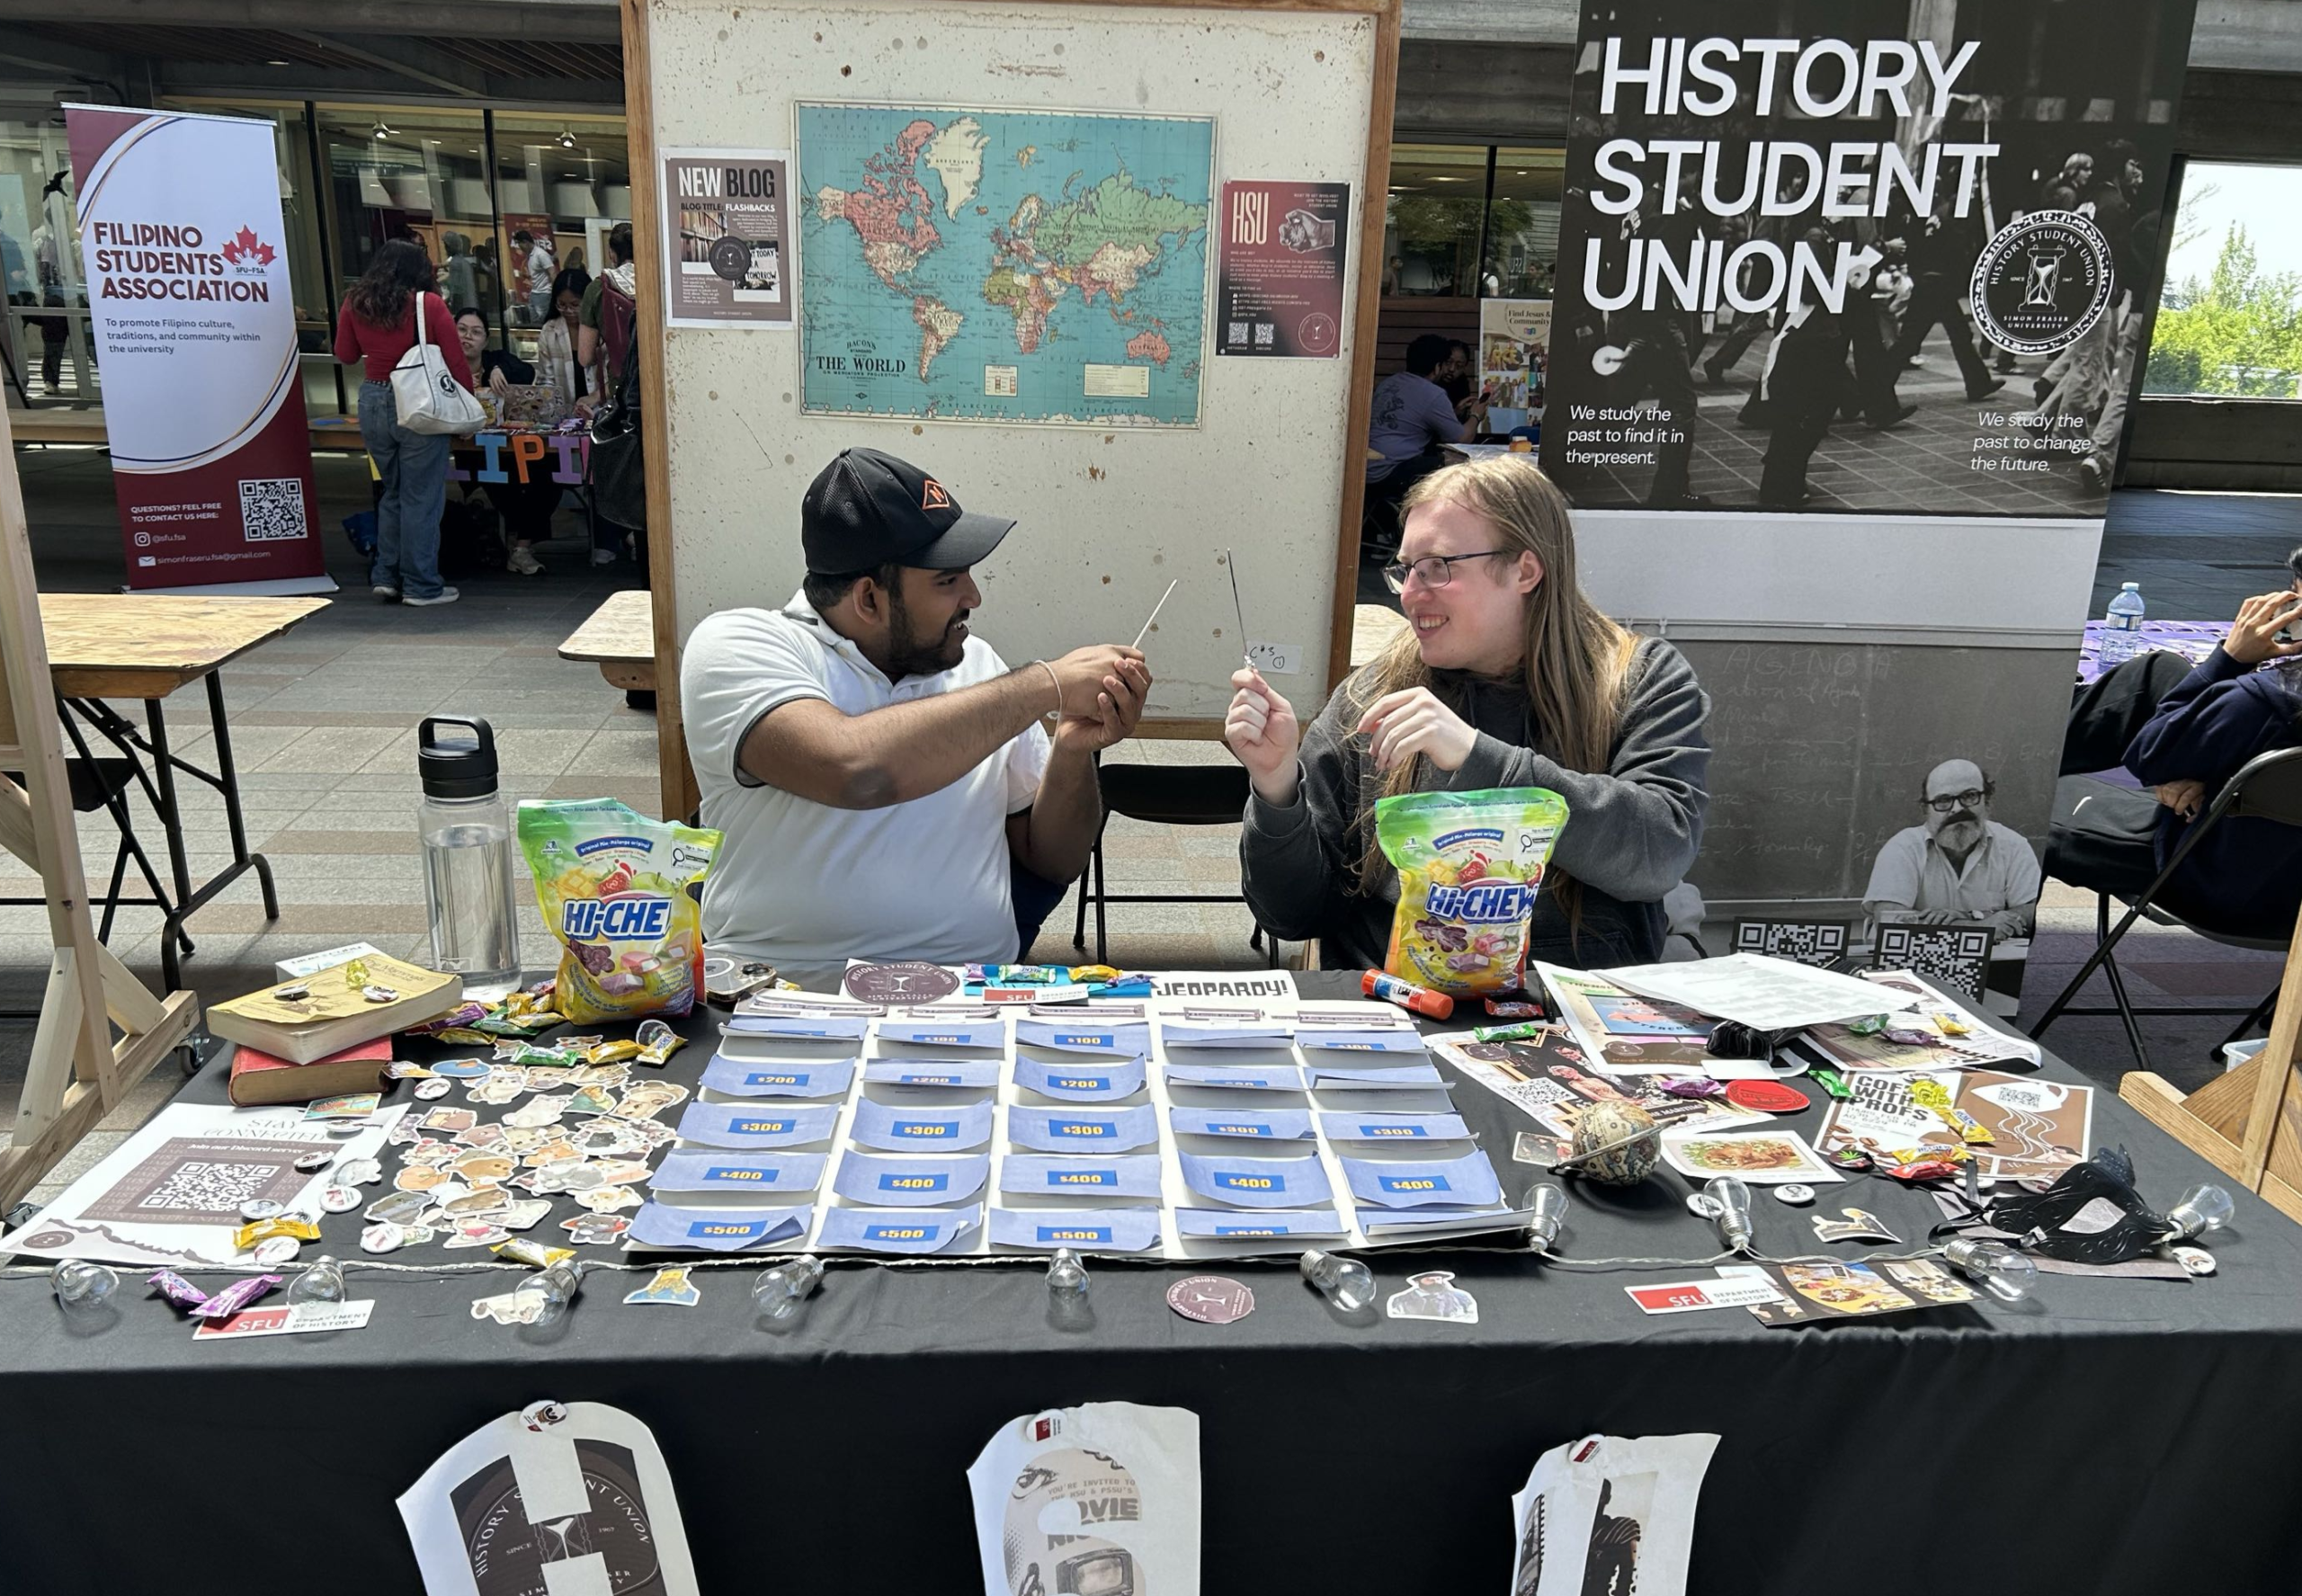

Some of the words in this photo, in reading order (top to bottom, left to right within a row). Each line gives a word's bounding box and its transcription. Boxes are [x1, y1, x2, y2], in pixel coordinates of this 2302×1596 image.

[1600, 38, 1981, 118] HISTORY
[678, 166, 721, 197] NEW
[726, 167, 775, 198] BLOG
[1589, 139, 2000, 218] STUDENT
[681, 202, 701, 211] BLOG
[725, 203, 776, 212] FLASHBACKS
[1231, 192, 1269, 245] HSU
[94, 222, 202, 248] FILIPINO
[2030, 230, 2082, 249] STUDENT
[96, 249, 224, 276] STUDENTS
[1989, 238, 2025, 285] HISTORY
[2079, 247, 2095, 286] UNION
[1583, 238, 1858, 315] UNION
[101, 277, 270, 302] ASSOCIATION
[105, 318, 118, 327] To
[120, 319, 160, 329] promote
[162, 318, 197, 329] Filipino
[199, 320, 235, 330] culture,
[1510, 318, 1550, 326] Community
[107, 332, 157, 342] traditions,
[158, 333, 176, 341] and
[177, 333, 230, 343] community
[232, 334, 261, 342] within
[109, 344, 126, 353] the
[128, 344, 174, 354] university
[816, 356, 846, 370] THE
[852, 357, 906, 373] WORLD
[1570, 405, 1595, 421] We
[1599, 406, 1643, 424] study
[1646, 406, 1672, 421] the
[1978, 411, 2004, 426] We
[2008, 413, 2055, 431] study
[2057, 413, 2083, 428] the
[1567, 429, 1602, 445] past
[1605, 429, 1621, 442] to
[1624, 427, 1655, 442] find
[1657, 428, 1667, 442] it
[1671, 428, 1684, 443] in
[1973, 436, 2009, 451] past
[2013, 436, 2030, 450] to
[2033, 434, 2092, 454] change
[1566, 448, 1592, 463] the
[1594, 450, 1656, 468] present.
[1970, 455, 1996, 470] the
[2001, 456, 2051, 471] future.
[130, 504, 181, 513] QUESTIONS?
[183, 504, 202, 512] FEEL
[145, 513, 183, 522] CONTACT
[563, 899, 673, 938] HI-CHE
[852, 966, 879, 982] HISTORY
[882, 963, 934, 972] STUDENT
[1156, 980, 1289, 997] JEOPARDY!
[1067, 1037, 1102, 1045] $100
[757, 1075, 796, 1084] $200
[1059, 1079, 1098, 1088] $200
[1854, 1085, 1915, 1107] WITH
[1849, 1096, 1929, 1121] PROFS
[247, 1119, 298, 1129] STAY
[740, 1122, 783, 1131] $300
[904, 1125, 946, 1135] $300
[1062, 1126, 1104, 1135] $300
[1218, 1125, 1259, 1134] $300
[203, 1128, 326, 1140] CONNECTED
[1372, 1128, 1414, 1136] $300
[187, 1143, 210, 1151] Join
[230, 1144, 270, 1153] Discord
[269, 1146, 307, 1155] server
[719, 1170, 763, 1180] $400
[1059, 1174, 1102, 1183] $400
[891, 1178, 934, 1189] $400
[1228, 1177, 1271, 1190] $400
[1391, 1180, 1435, 1190] $400
[703, 1225, 751, 1235] $500
[878, 1228, 925, 1239] $500
[1052, 1231, 1099, 1240] $500
[1672, 1293, 1709, 1307] SFU
[1713, 1288, 1772, 1297] DEPARTMENT
[1732, 1294, 1771, 1303] HISTORY
[236, 1318, 284, 1333] SFU
[308, 1320, 356, 1328] HISTORY
[1048, 1481, 1077, 1494] YOU'RE
[1083, 1478, 1120, 1487] INVITED
[1101, 1487, 1133, 1495] PSSU'S
[1078, 1497, 1139, 1519] OVIE
[613, 1495, 650, 1545] UNION
[476, 1504, 510, 1578] HISTORY
[505, 1541, 532, 1555] SINCE
